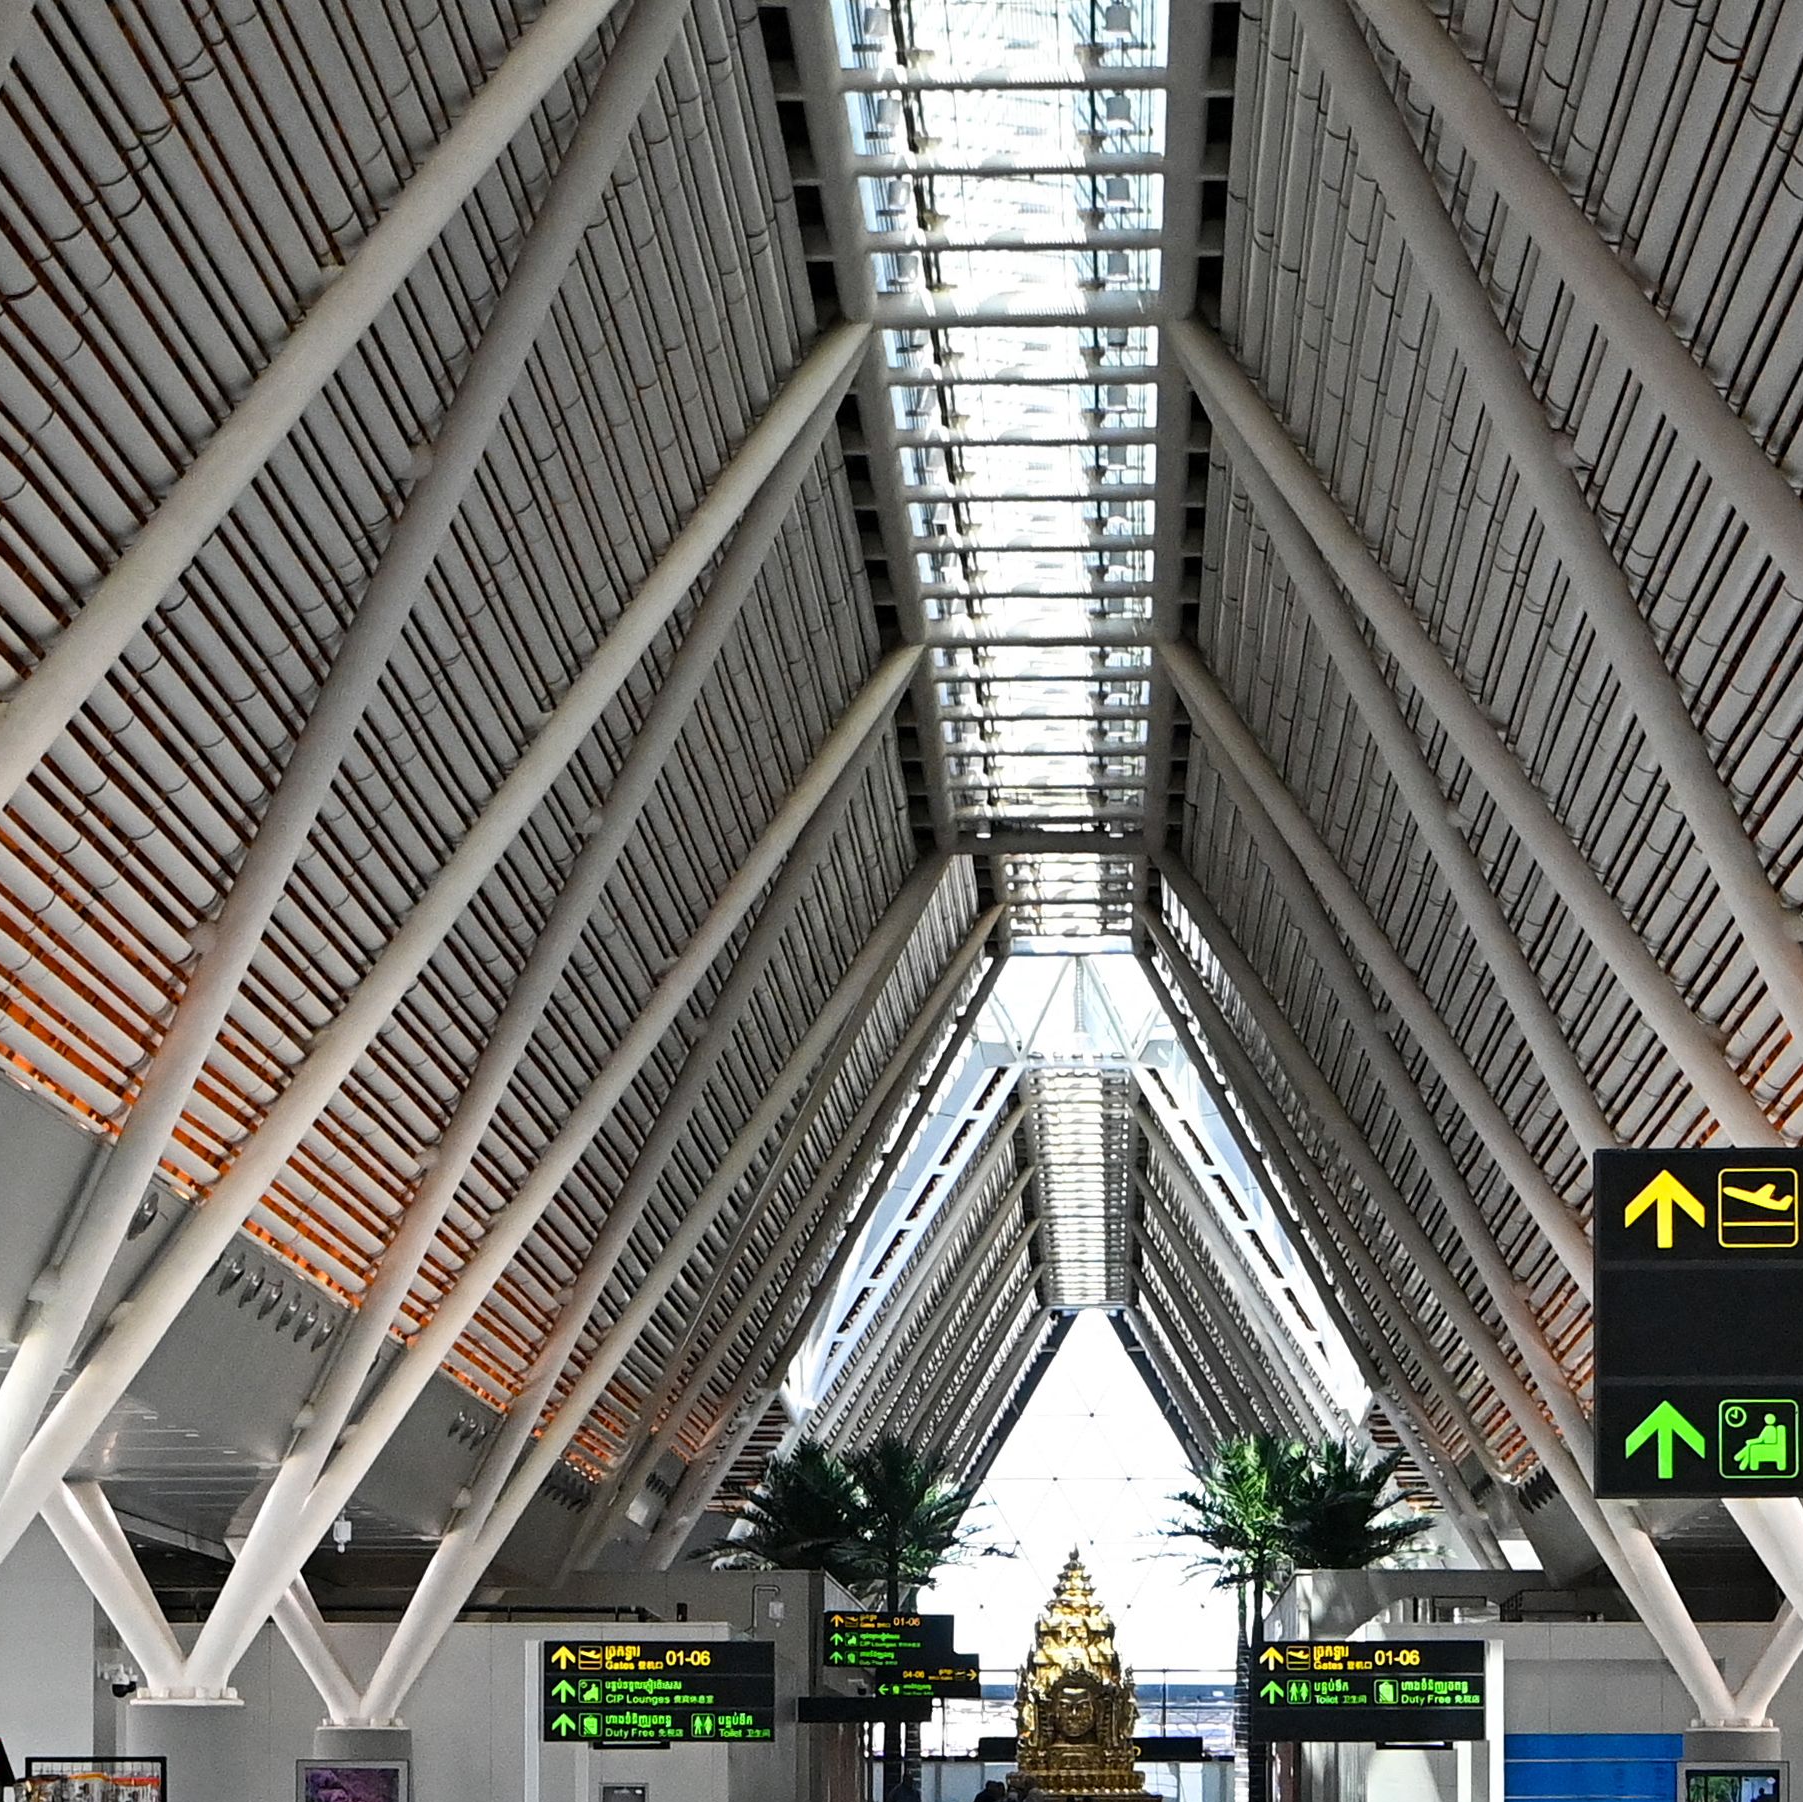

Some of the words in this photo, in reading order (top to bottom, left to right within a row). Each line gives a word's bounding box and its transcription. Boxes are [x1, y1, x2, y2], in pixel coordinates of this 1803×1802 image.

[605, 1660, 634, 1670] Gates
[666, 1651, 710, 1665] 01-06
[1314, 1661, 1343, 1670] Gates
[1375, 1650, 1420, 1665] 01-06
[606, 1694, 624, 1703] CIP
[627, 1694, 670, 1705] Lounges
[1401, 1695, 1424, 1705] Duty
[1428, 1695, 1451, 1703] Free
[606, 1728, 628, 1738] Duty
[632, 1727, 654, 1737] Free
[719, 1727, 742, 1737] Toilet
